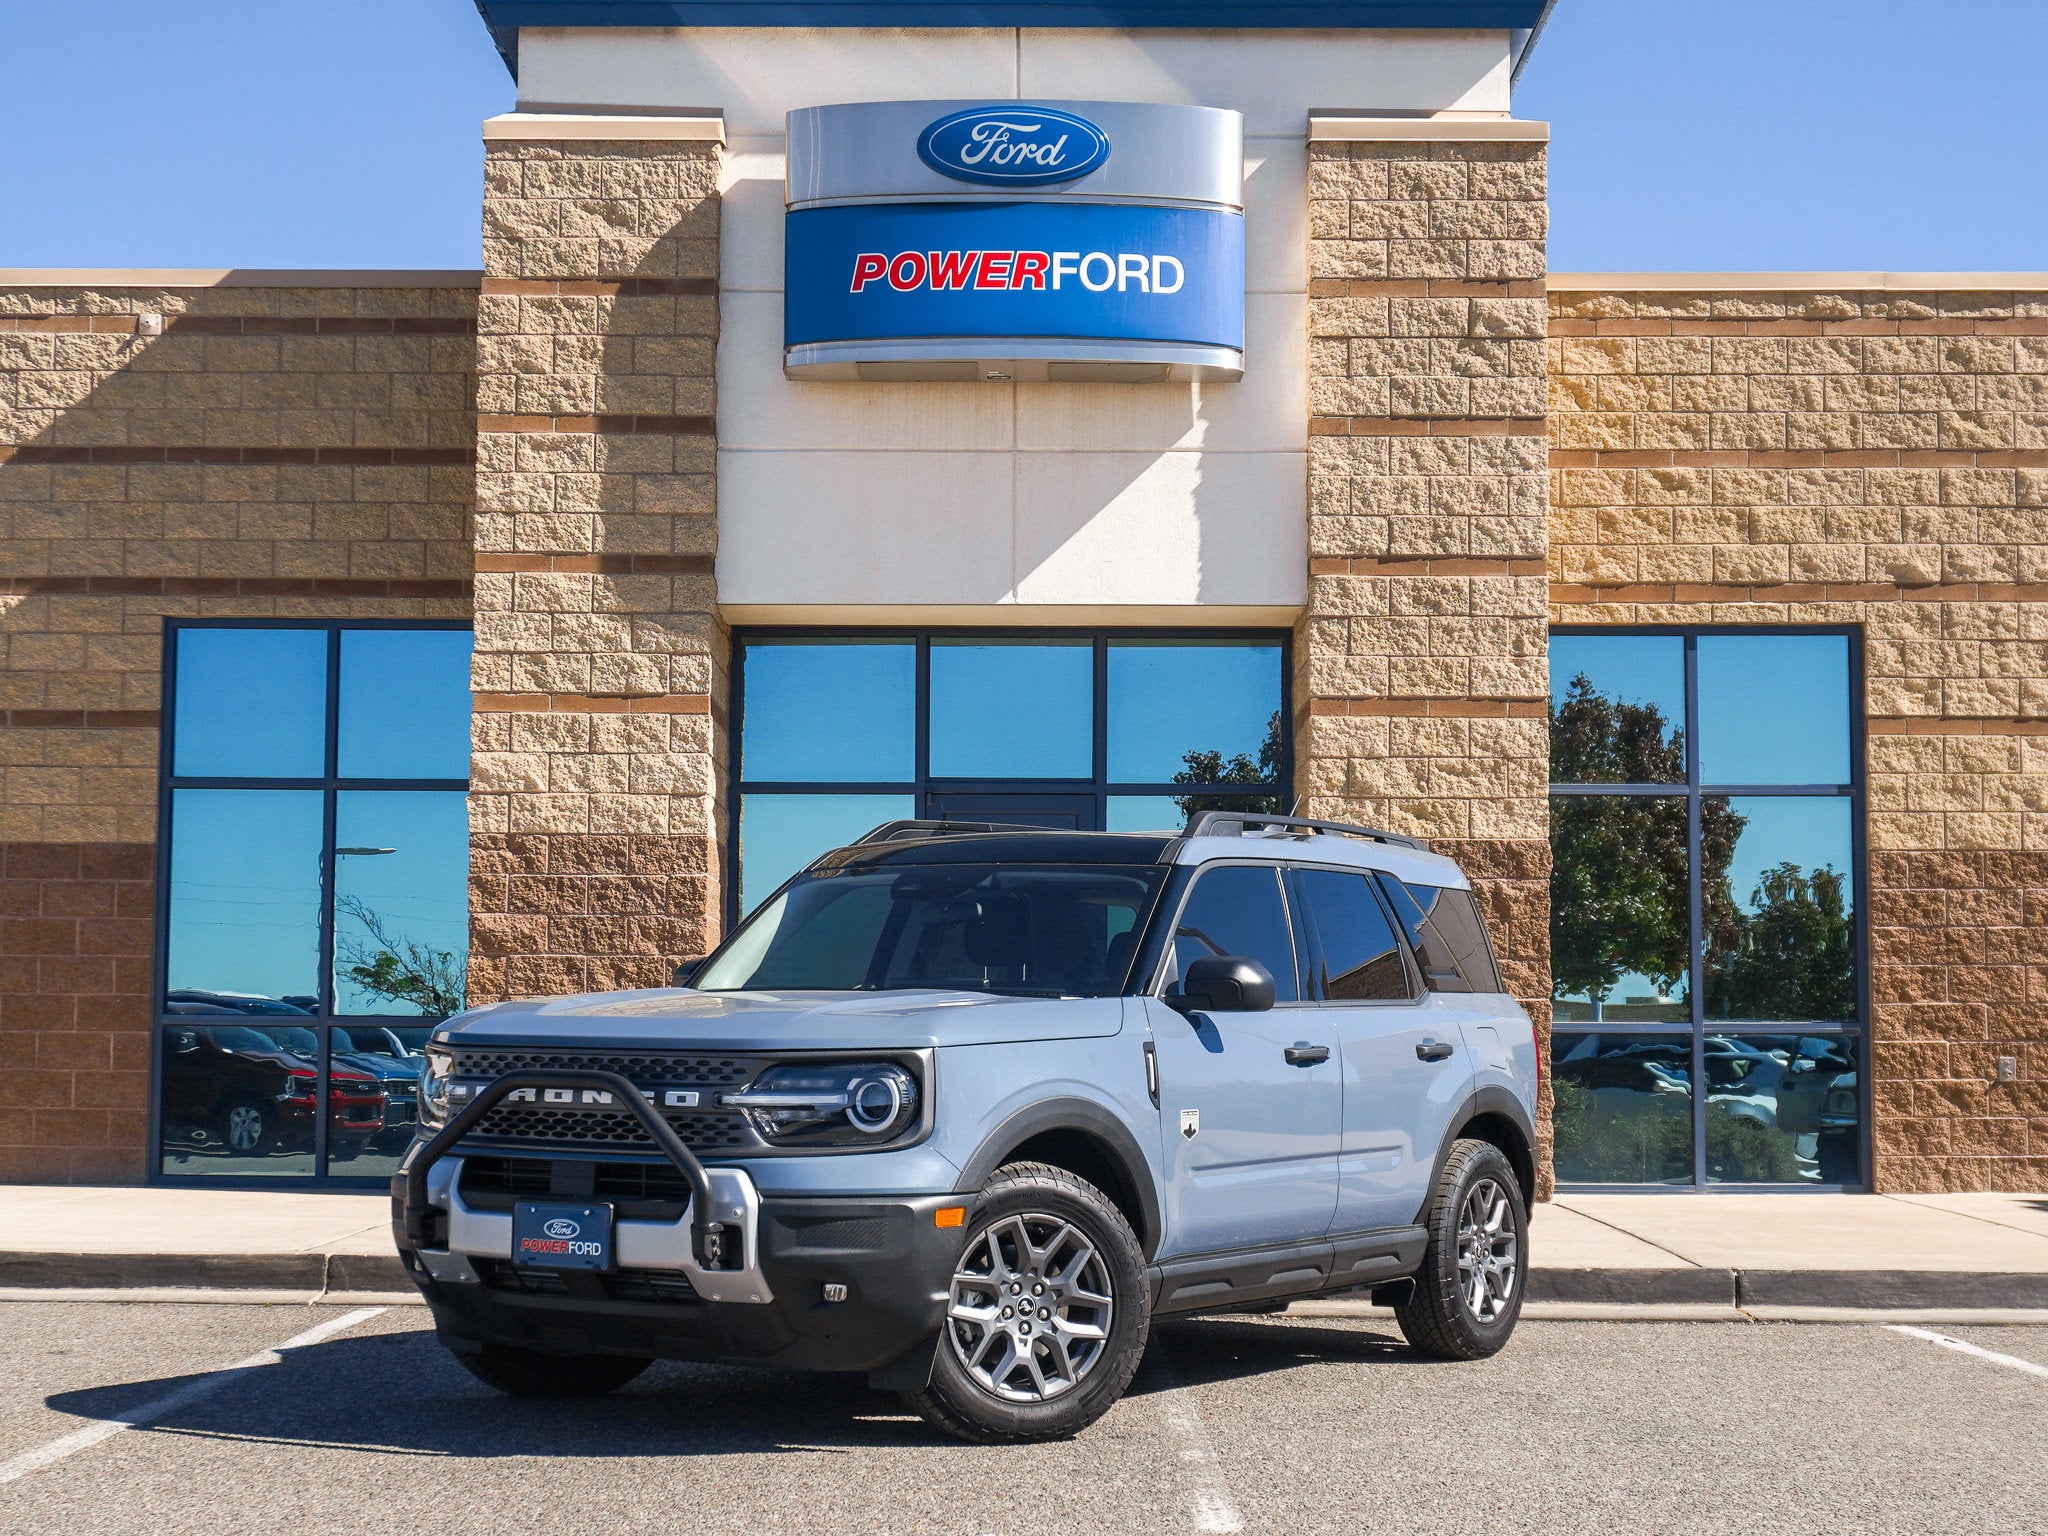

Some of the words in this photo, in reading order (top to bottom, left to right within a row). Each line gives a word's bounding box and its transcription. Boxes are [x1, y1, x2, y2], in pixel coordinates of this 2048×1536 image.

[960, 121, 1068, 166] Ford
[849, 250, 1185, 294] POWERFORD
[550, 1222, 574, 1236] Ford
[521, 1238, 602, 1256] POWERFORD
